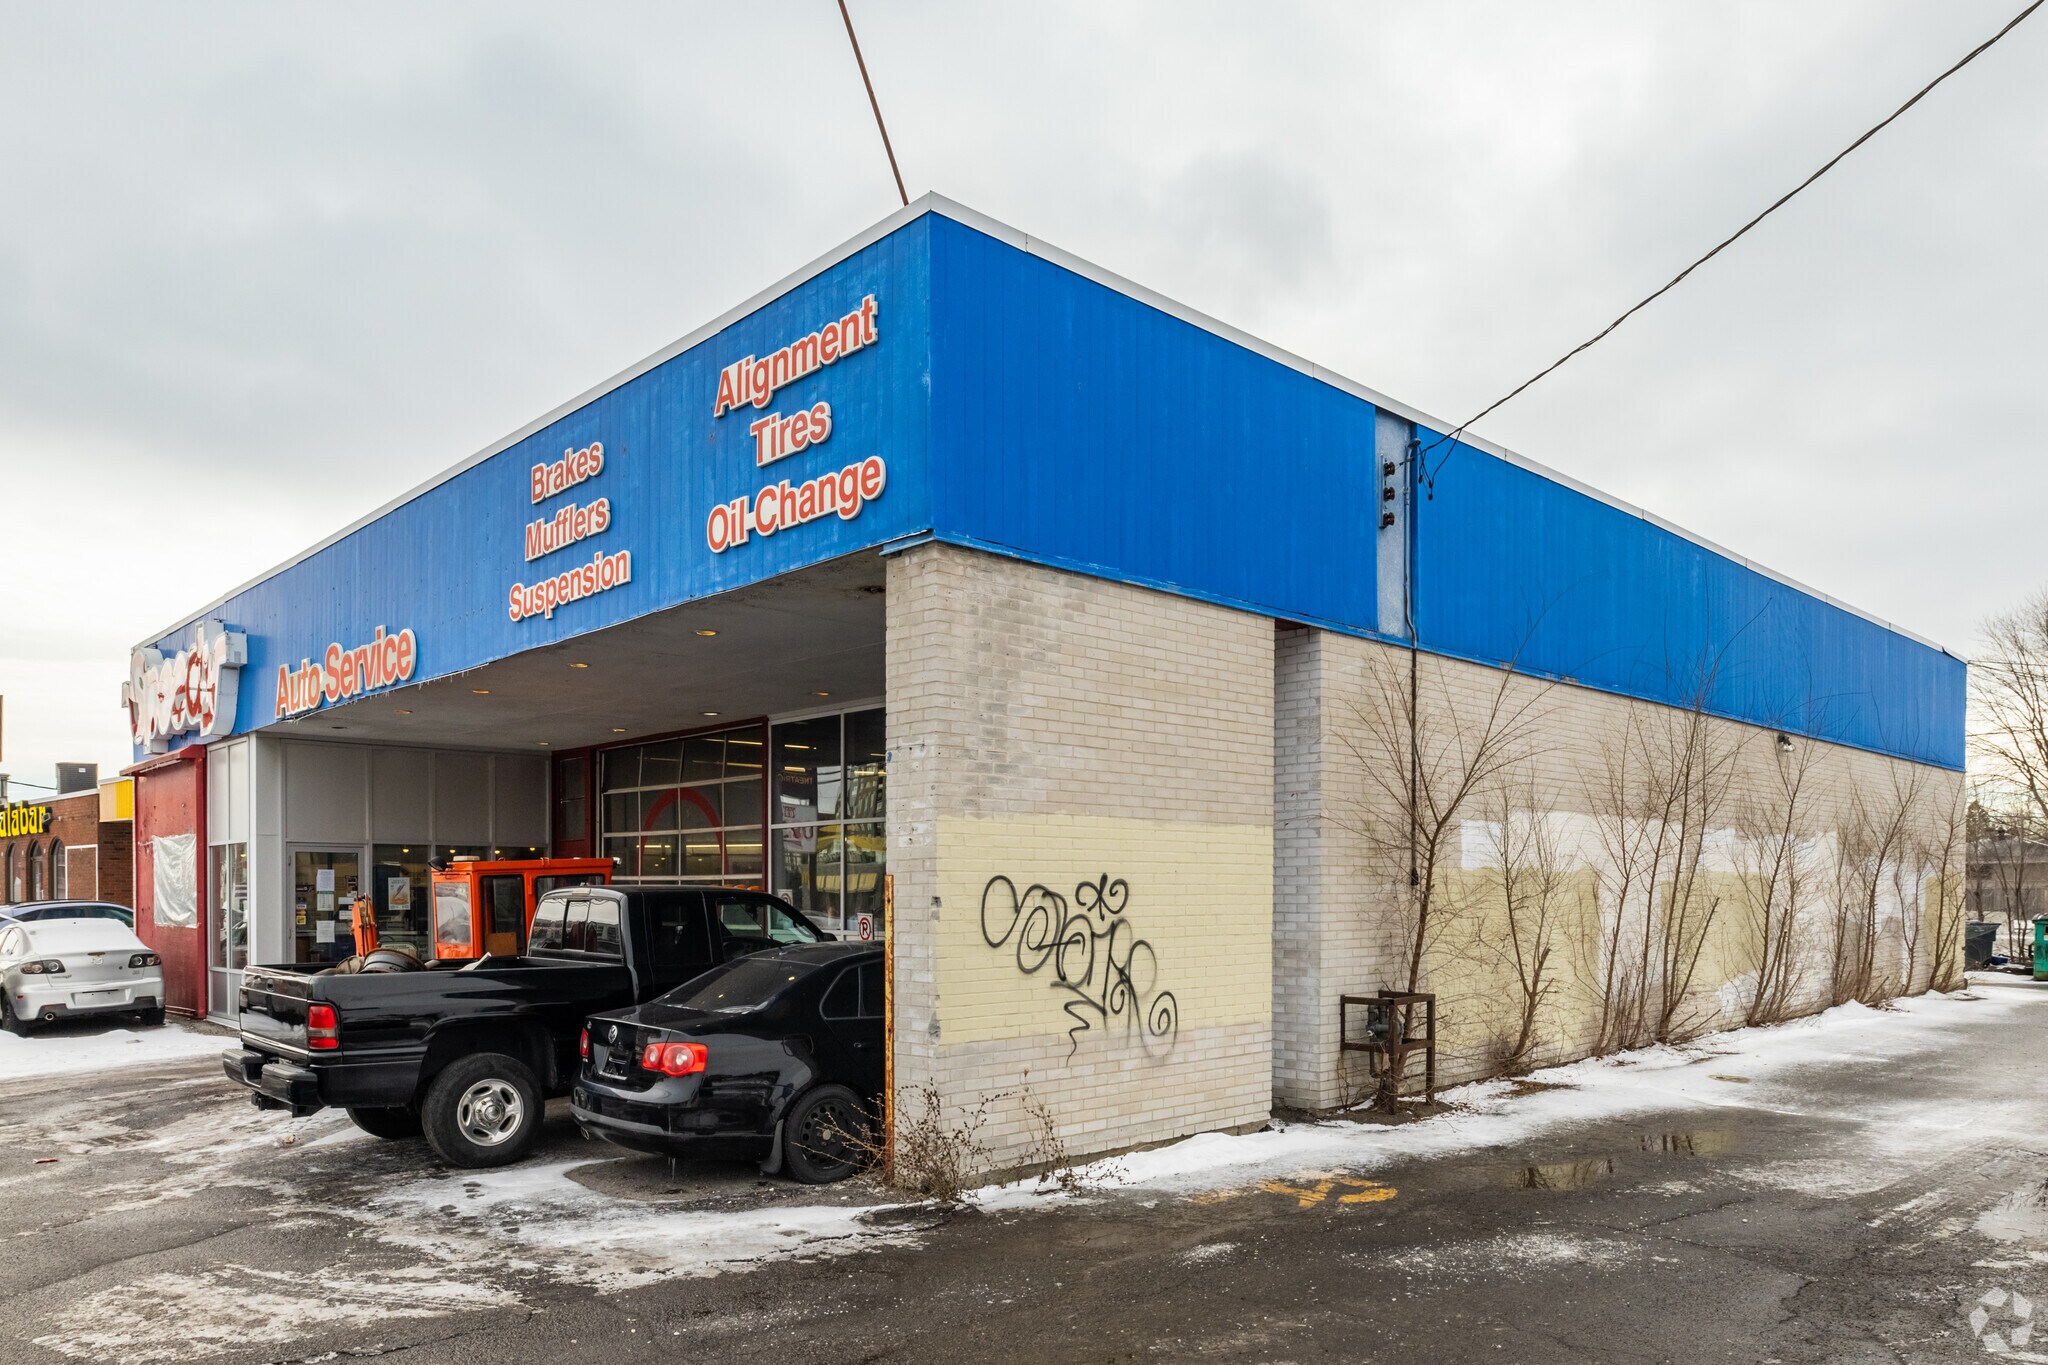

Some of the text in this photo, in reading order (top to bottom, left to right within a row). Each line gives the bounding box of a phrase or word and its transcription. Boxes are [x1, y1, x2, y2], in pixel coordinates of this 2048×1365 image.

[714, 294, 878, 417] Alignment
[750, 402, 832, 467] Tires
[531, 441, 604, 504] Brakes
[525, 498, 611, 562] Mufflers
[509, 550, 631, 621] Suspension
[275, 624, 416, 719] Auto Service
